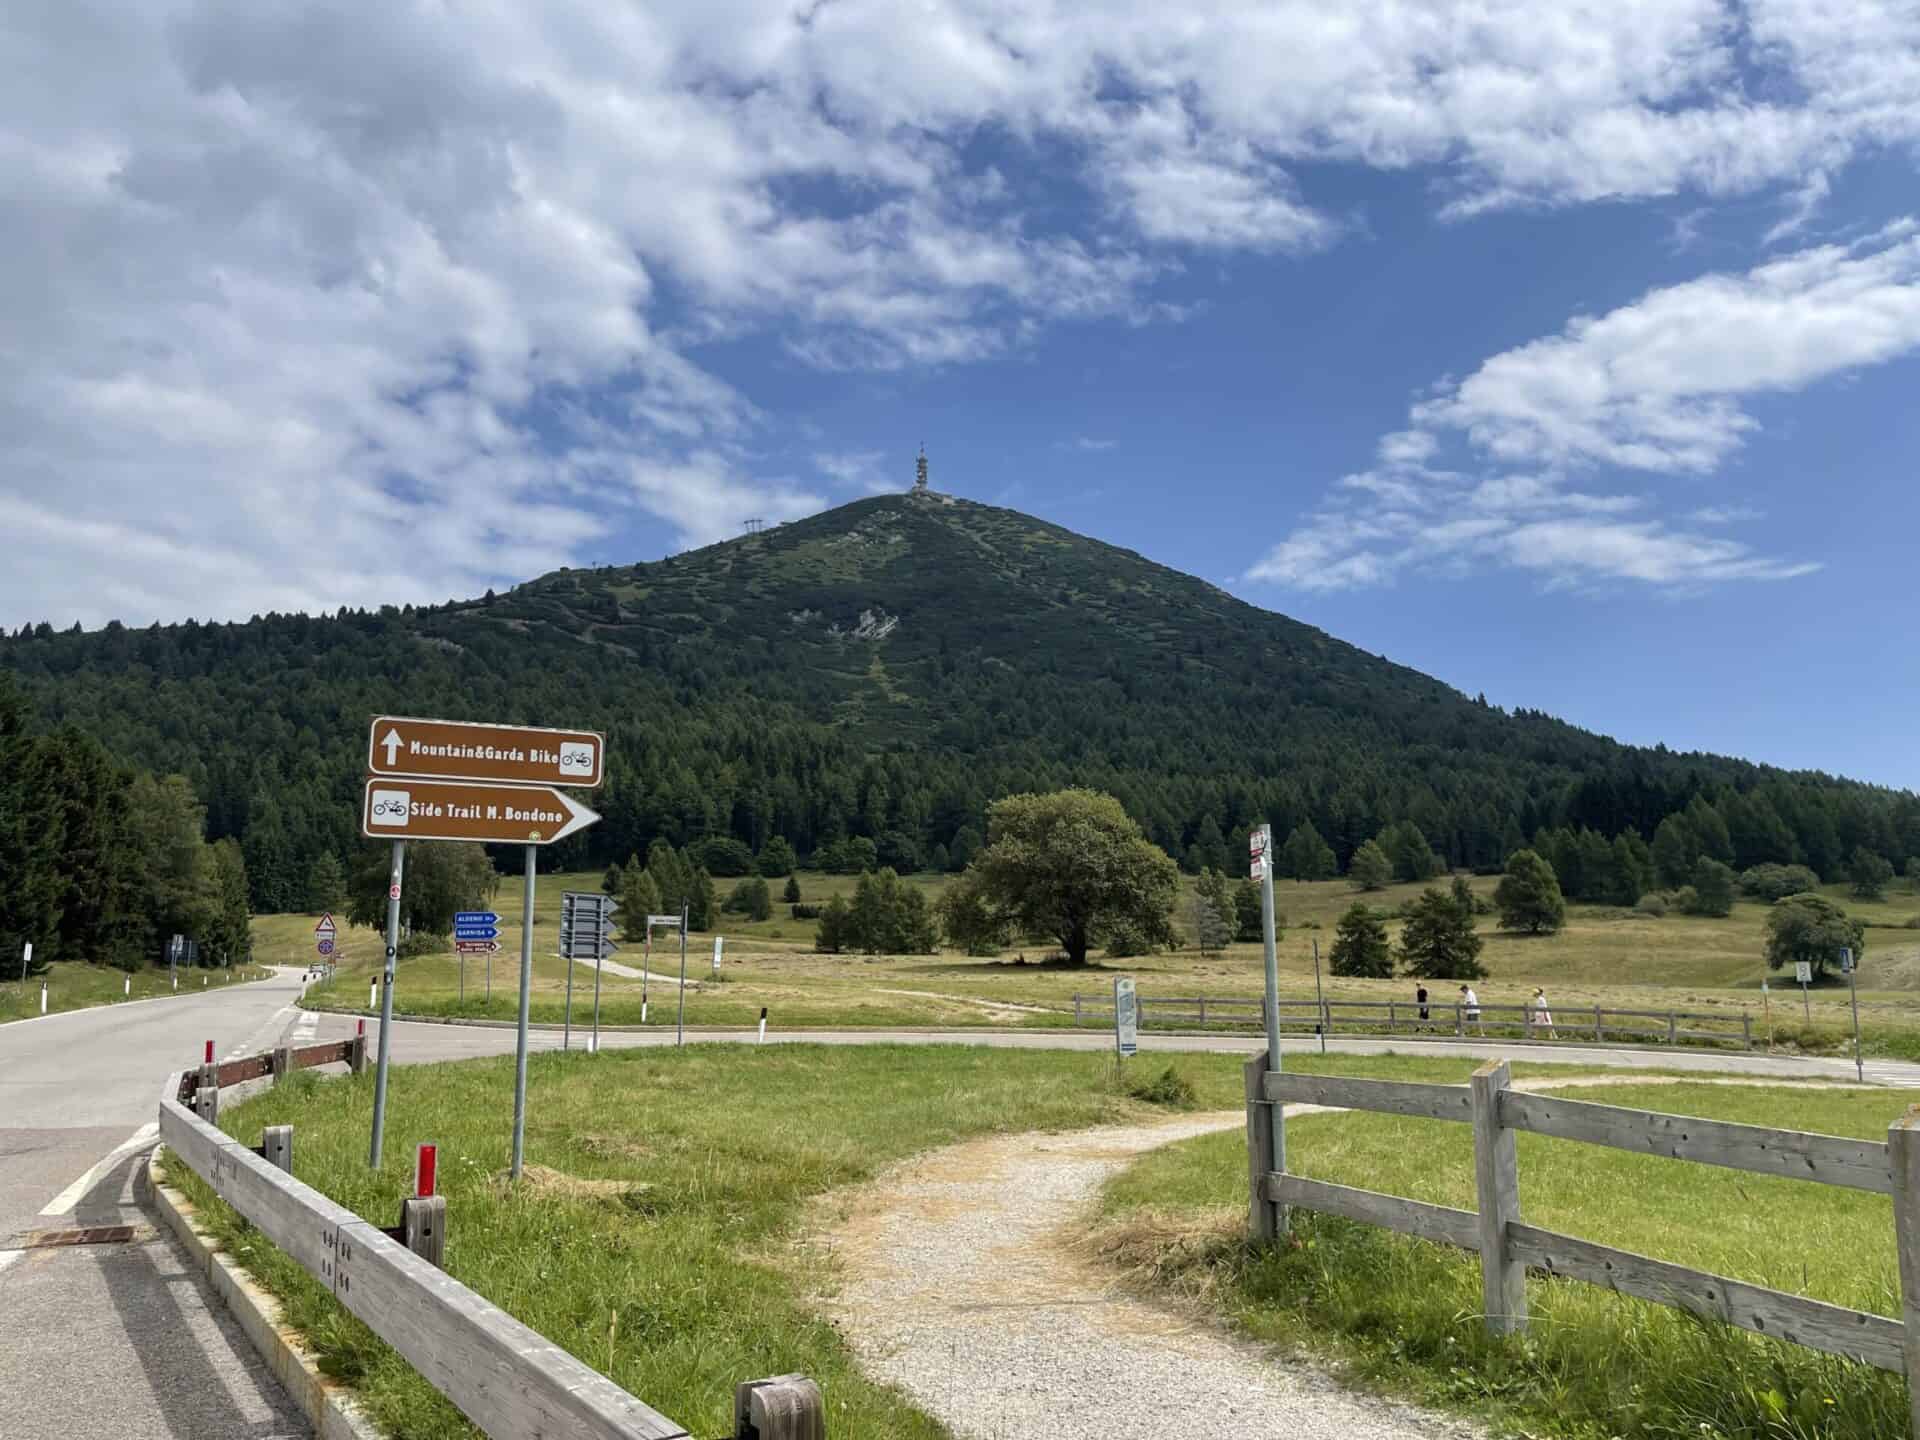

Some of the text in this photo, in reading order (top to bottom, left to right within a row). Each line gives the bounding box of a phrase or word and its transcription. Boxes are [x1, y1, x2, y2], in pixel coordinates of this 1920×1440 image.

[410, 740, 559, 764] Mountain&Garda Bike
[410, 802, 442, 817] Side
[447, 804, 481, 819] Trail
[505, 804, 563, 823] Bondone
